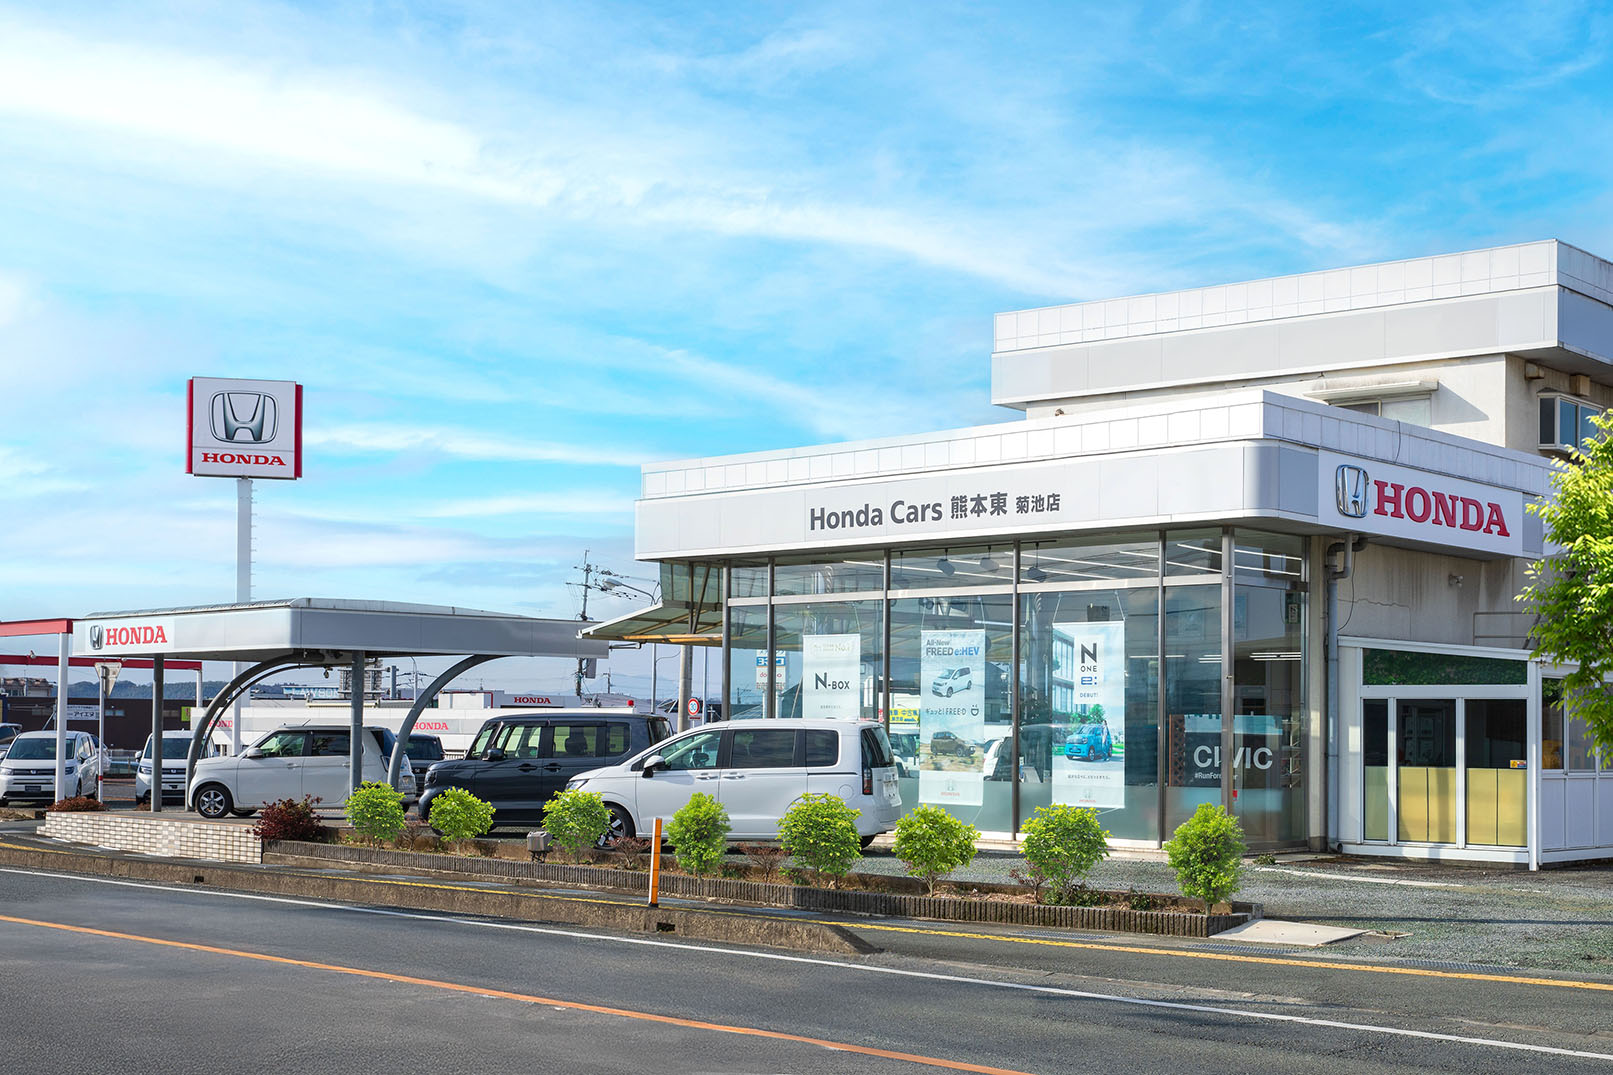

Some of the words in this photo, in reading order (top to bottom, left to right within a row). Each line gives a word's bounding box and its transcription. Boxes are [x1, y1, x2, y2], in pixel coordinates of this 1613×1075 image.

[201, 452, 287, 466] HONDA
[810, 503, 884, 531] Honda
[890, 500, 943, 524] Cars
[950, 492, 1008, 520] 熊本東
[1015, 493, 1061, 515] 菊池店
[1373, 479, 1510, 538] HONDA
[105, 625, 168, 646] HONDA
[926, 647, 953, 656] FREED
[954, 646, 980, 656] e:HEV
[1080, 642, 1098, 664] N
[1080, 665, 1098, 673] ONE
[815, 672, 850, 690] N-BOX
